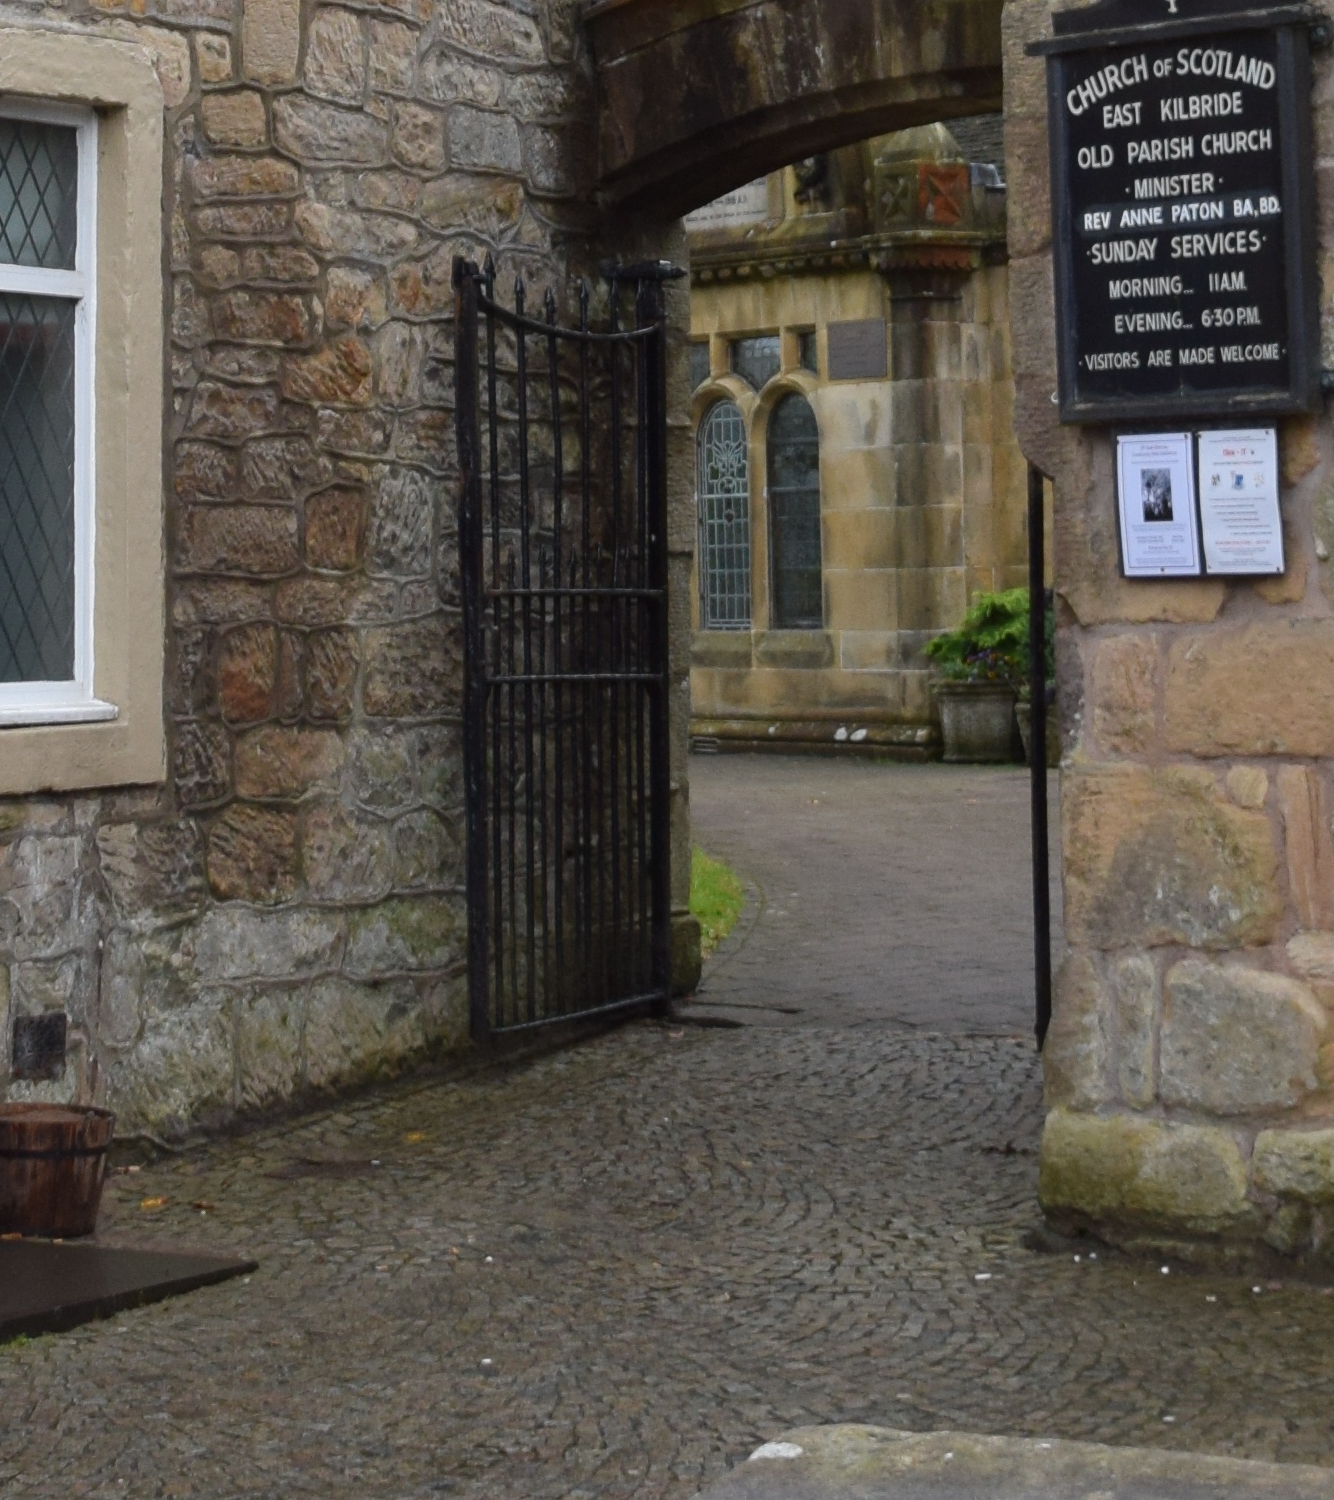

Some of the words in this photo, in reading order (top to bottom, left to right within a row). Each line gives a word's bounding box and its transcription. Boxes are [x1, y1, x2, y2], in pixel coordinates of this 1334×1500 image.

[1067, 54, 1149, 116] CHURCH
[1153, 58, 1173, 78] OF
[1176, 49, 1276, 90] SCOTLAND
[1103, 101, 1142, 129] EAST
[1160, 91, 1243, 122] KILBRIDE
[1077, 144, 1114, 170] OLD
[1127, 136, 1194, 164] PARISH
[1201, 128, 1273, 157] CHURCH
[1134, 172, 1215, 200] MINISTER
[1084, 211, 1111, 231] REV
[1120, 206, 1163, 228] ANNE
[1171, 201, 1224, 223] PATON
[1092, 237, 1158, 265] SUNDAY
[1170, 229, 1261, 259] SERVICES
[1085, 351, 1139, 371] VISITORS
[1147, 349, 1172, 367] ARE
[1179, 347, 1215, 364] MADE
[1220, 343, 1279, 363] WELCOME
